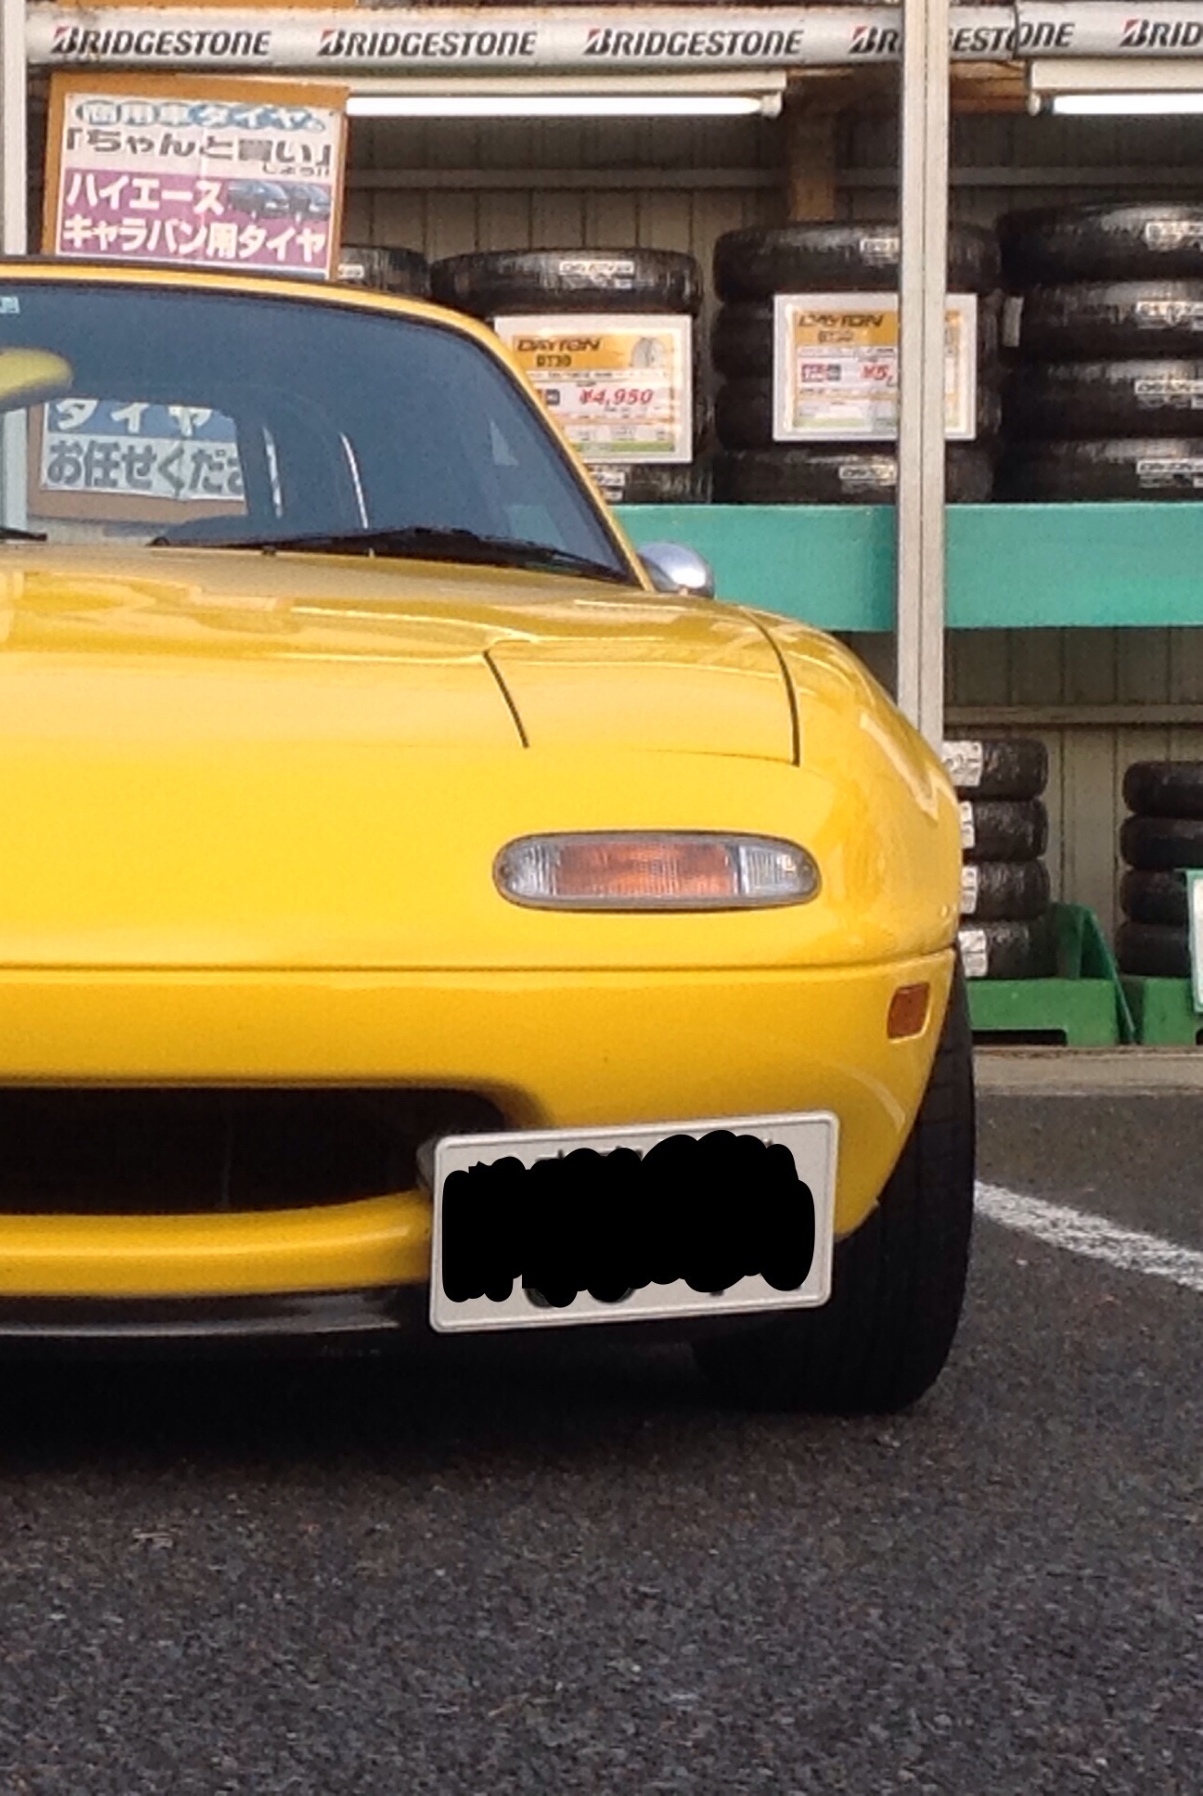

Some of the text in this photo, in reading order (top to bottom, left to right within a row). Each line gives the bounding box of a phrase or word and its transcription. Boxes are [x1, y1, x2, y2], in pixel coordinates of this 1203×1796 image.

[50, 26, 272, 56] BRIDGESTONE
[317, 28, 538, 57] BRIDGESTONE
[584, 28, 804, 57] BRIDGESTONE
[849, 22, 1075, 54] BRESTONE
[66, 173, 224, 216] ハイエース
[63, 214, 326, 262] キャラバン用タイヤ
[517, 337, 602, 351] DAYTON
[579, 387, 654, 407] ¥4,950
